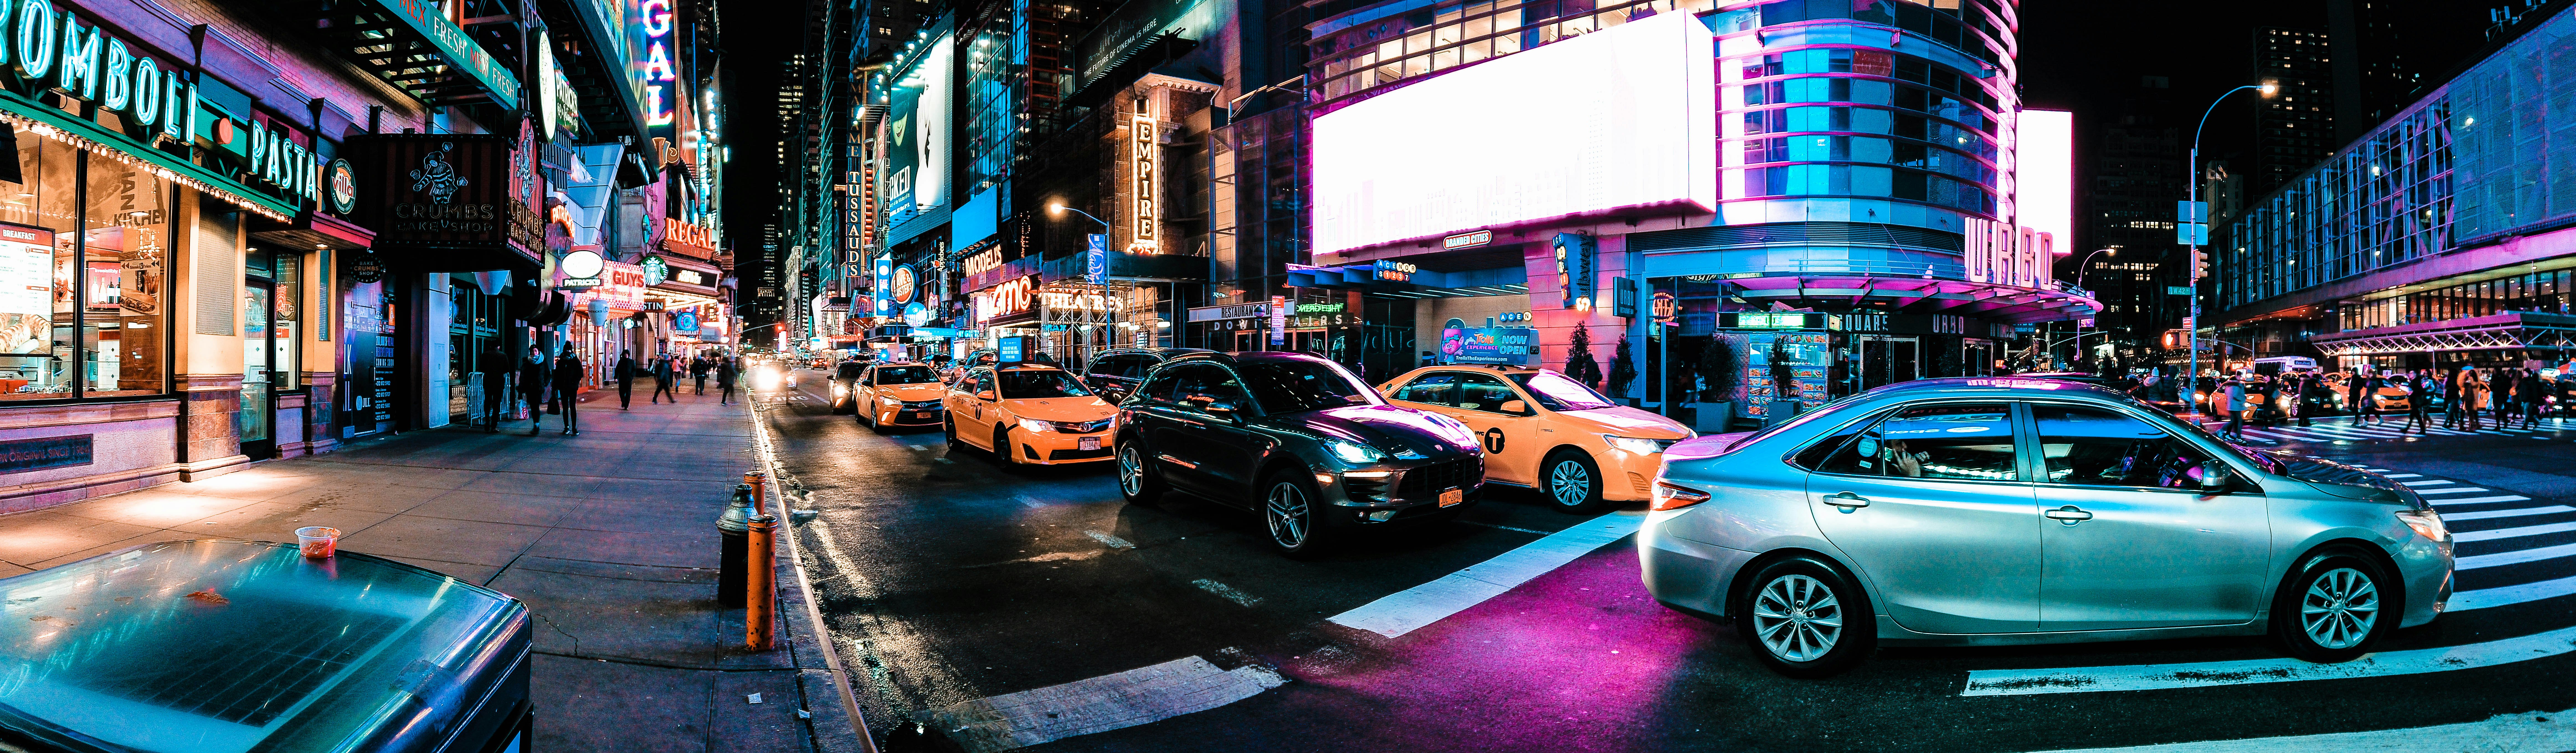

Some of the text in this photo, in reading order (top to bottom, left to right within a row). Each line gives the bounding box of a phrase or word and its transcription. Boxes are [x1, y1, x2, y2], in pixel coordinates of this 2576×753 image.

[1084, 18, 1157, 78] THE FUTURE OF CINEMA IS HERE
[434, 16, 466, 59] FRESH
[470, 46, 488, 78] MEX
[493, 66, 515, 100] FRESH
[556, 71, 578, 116] PATRICK'S
[250, 119, 317, 202] PASTA
[331, 175, 354, 199] villa
[1138, 123, 1153, 237] EMPIRE
[333, 192, 344, 211] STROMBOLI
[395, 203, 494, 220] CRUMBS
[511, 197, 543, 238] CRUMBS
[396, 221, 493, 233] BAKE SHOP
[552, 205, 575, 238] PATRICK'S
[2, 229, 35, 241] BREAKFAST
[511, 222, 543, 254] BAKE SHOP
[666, 217, 716, 251] REGAL
[1445, 232, 1489, 248] BRANDED CITIES
[965, 243, 1002, 277] MODELL'S
[1965, 216, 2053, 291] URBO
[613, 270, 644, 287] GUYS
[906, 273, 911, 282] &
[1620, 289, 1634, 306] URBO
[1221, 305, 1256, 319] RESTAURANT
[1837, 314, 1888, 331] SQUARE
[1932, 314, 1964, 334] URBO
[1474, 333, 1494, 345] Trolls
[1502, 335, 1528, 344] NOW
[1499, 345, 1527, 355] OPEN
[362, 398, 371, 408] JLL
[9, 450, 46, 462] ORIGINAL
[48, 447, 69, 458] SINCE
[1451, 491, 1461, 502] 2846
